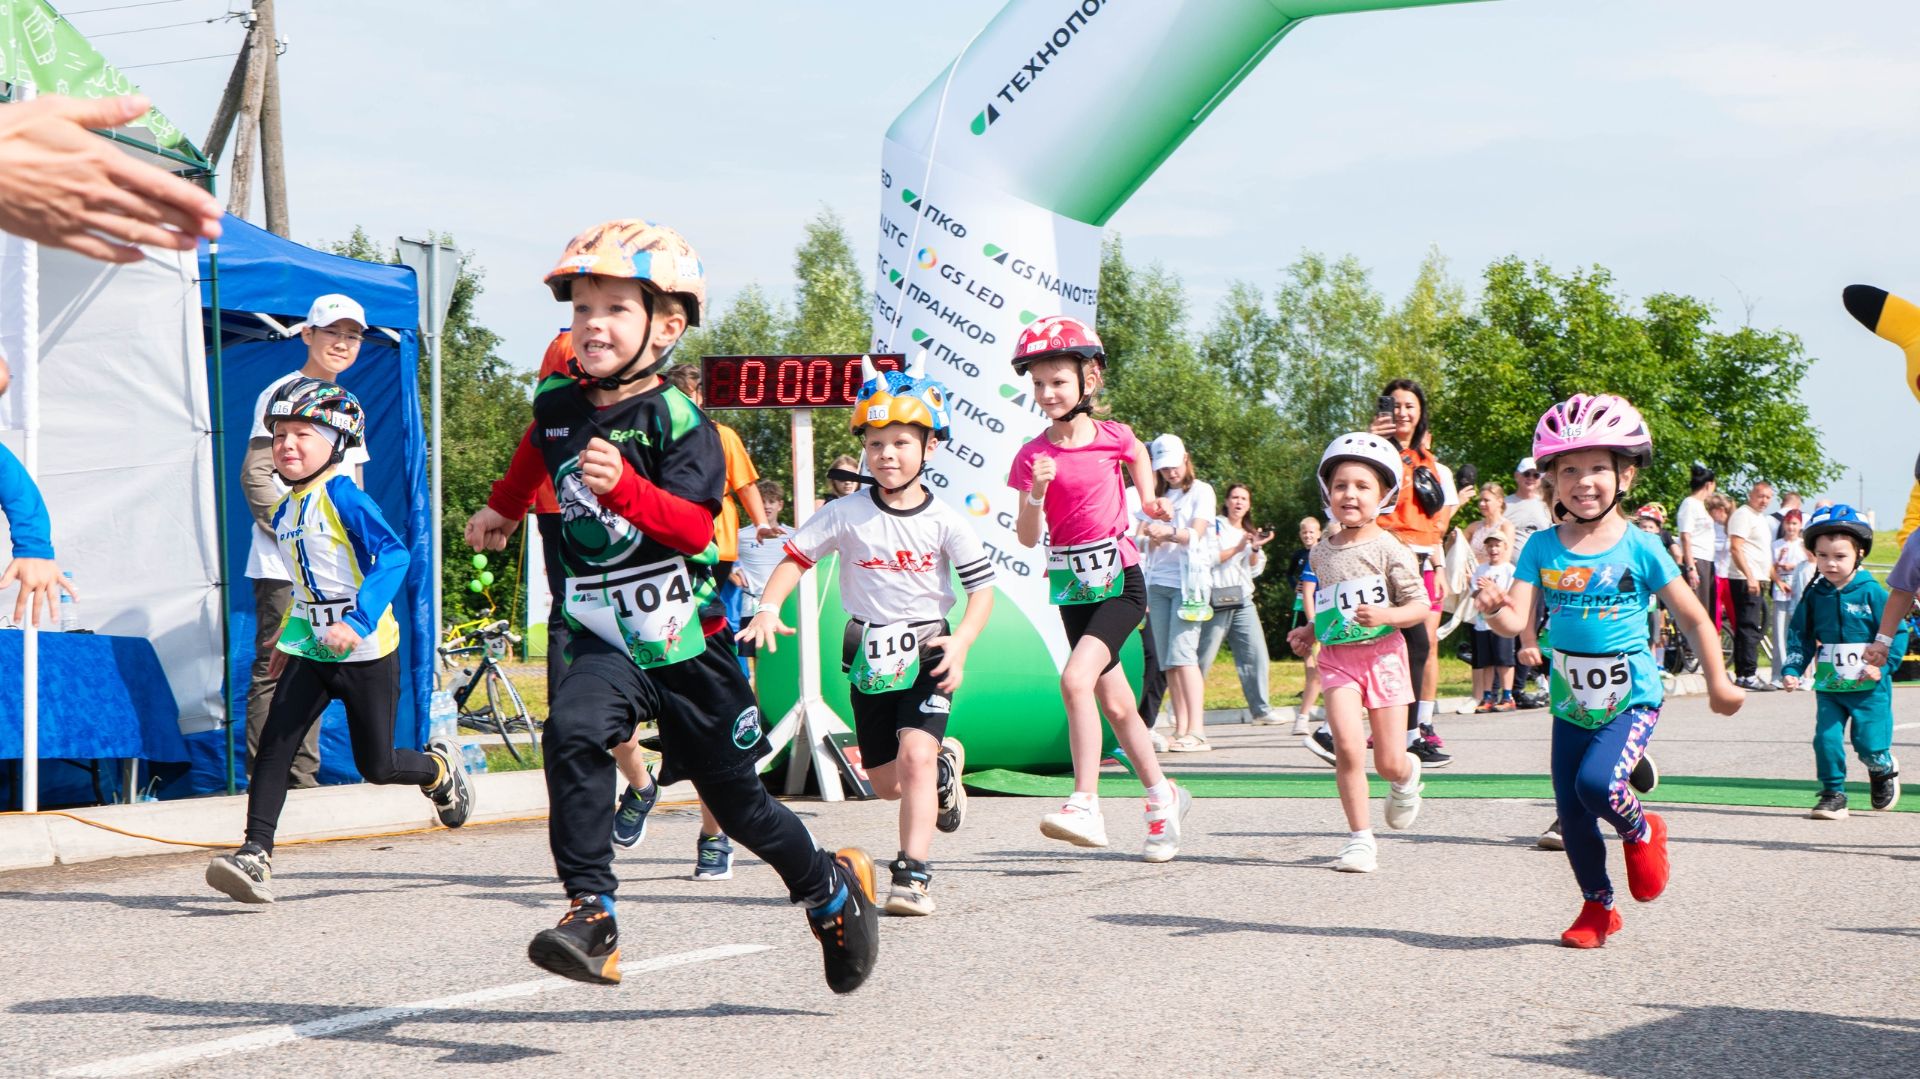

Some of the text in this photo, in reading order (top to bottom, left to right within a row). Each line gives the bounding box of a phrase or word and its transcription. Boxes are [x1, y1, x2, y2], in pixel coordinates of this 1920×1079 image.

[997, 0, 1105, 103] ТЕХНОПО
[924, 205, 967, 239] ПКФ
[1011, 259, 1036, 280] GS
[940, 264, 1004, 309] GS LED
[906, 283, 996, 346] ПРАНКОР
[935, 344, 980, 378] ПКФ
[955, 397, 1005, 434] ПКФ
[945, 437, 985, 468] LED
[921, 463, 949, 488] КФ
[982, 541, 1030, 577] ПКФ
[1073, 548, 1117, 573] 117
[612, 574, 691, 618] 104
[1340, 586, 1386, 610] 113
[868, 632, 916, 659] 110
[1835, 652, 1869, 667] 10
[1569, 662, 1628, 690] 105
